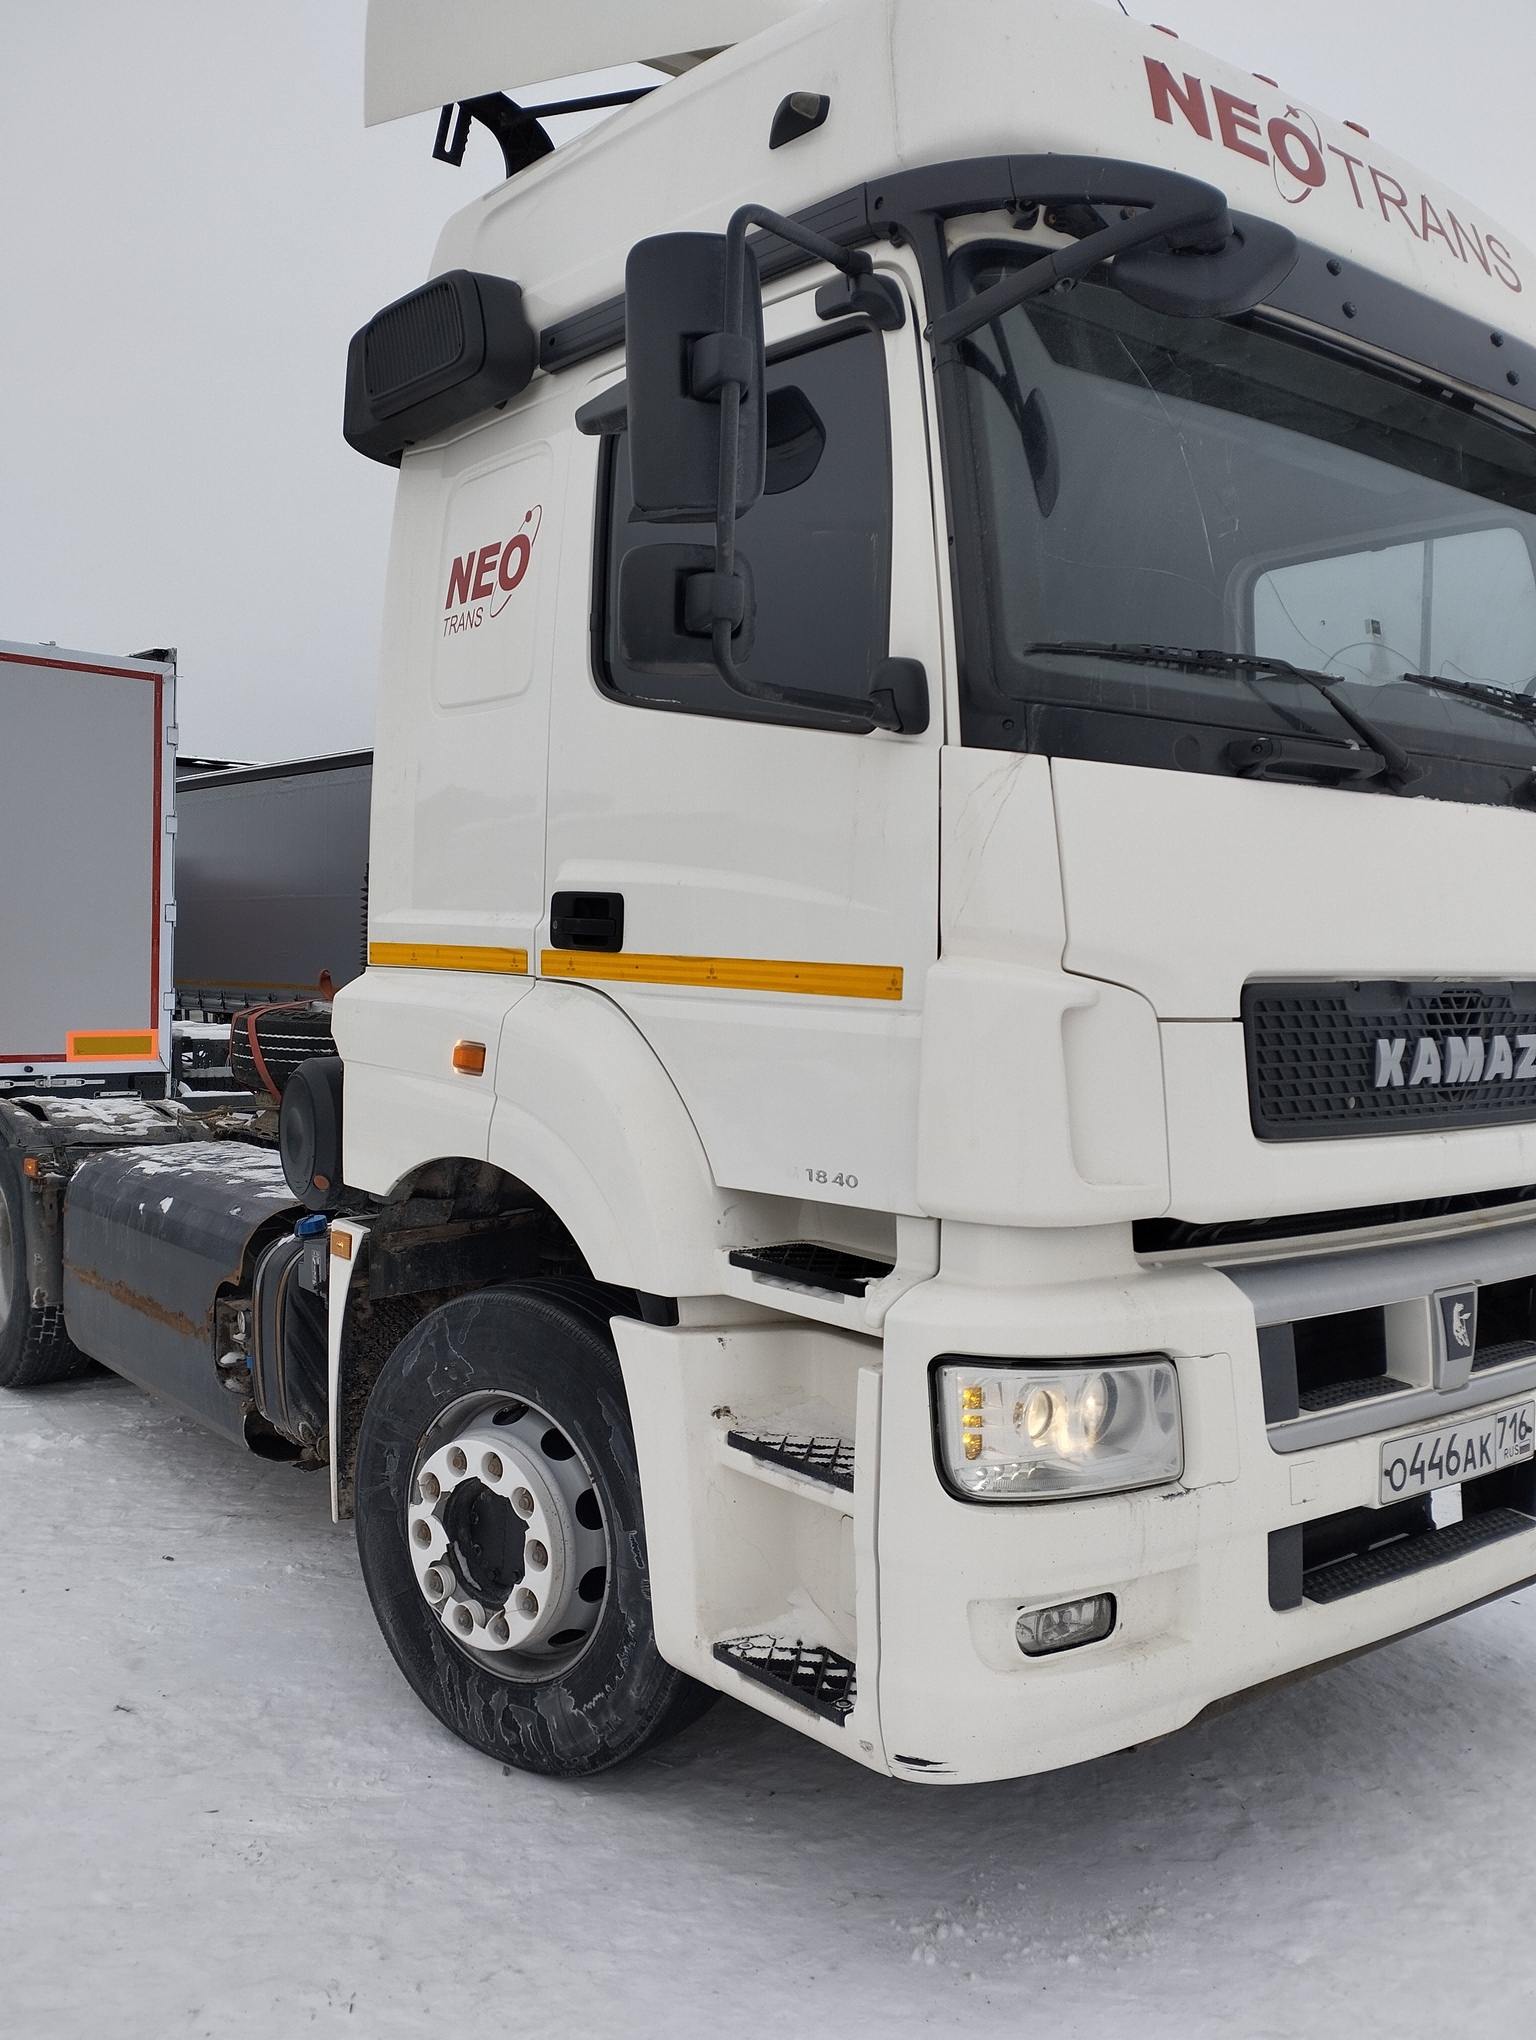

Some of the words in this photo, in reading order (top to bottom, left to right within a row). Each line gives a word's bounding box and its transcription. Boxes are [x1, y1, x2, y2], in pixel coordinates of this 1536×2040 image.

[1327, 143, 1522, 293] TRANS
[445, 533, 531, 610] NEO
[443, 607, 483, 637] TRANS
[1374, 1034, 1536, 1089] KAMAZ
[1497, 1409, 1527, 1450] 716
[1504, 1444, 1520, 1461] RUS
